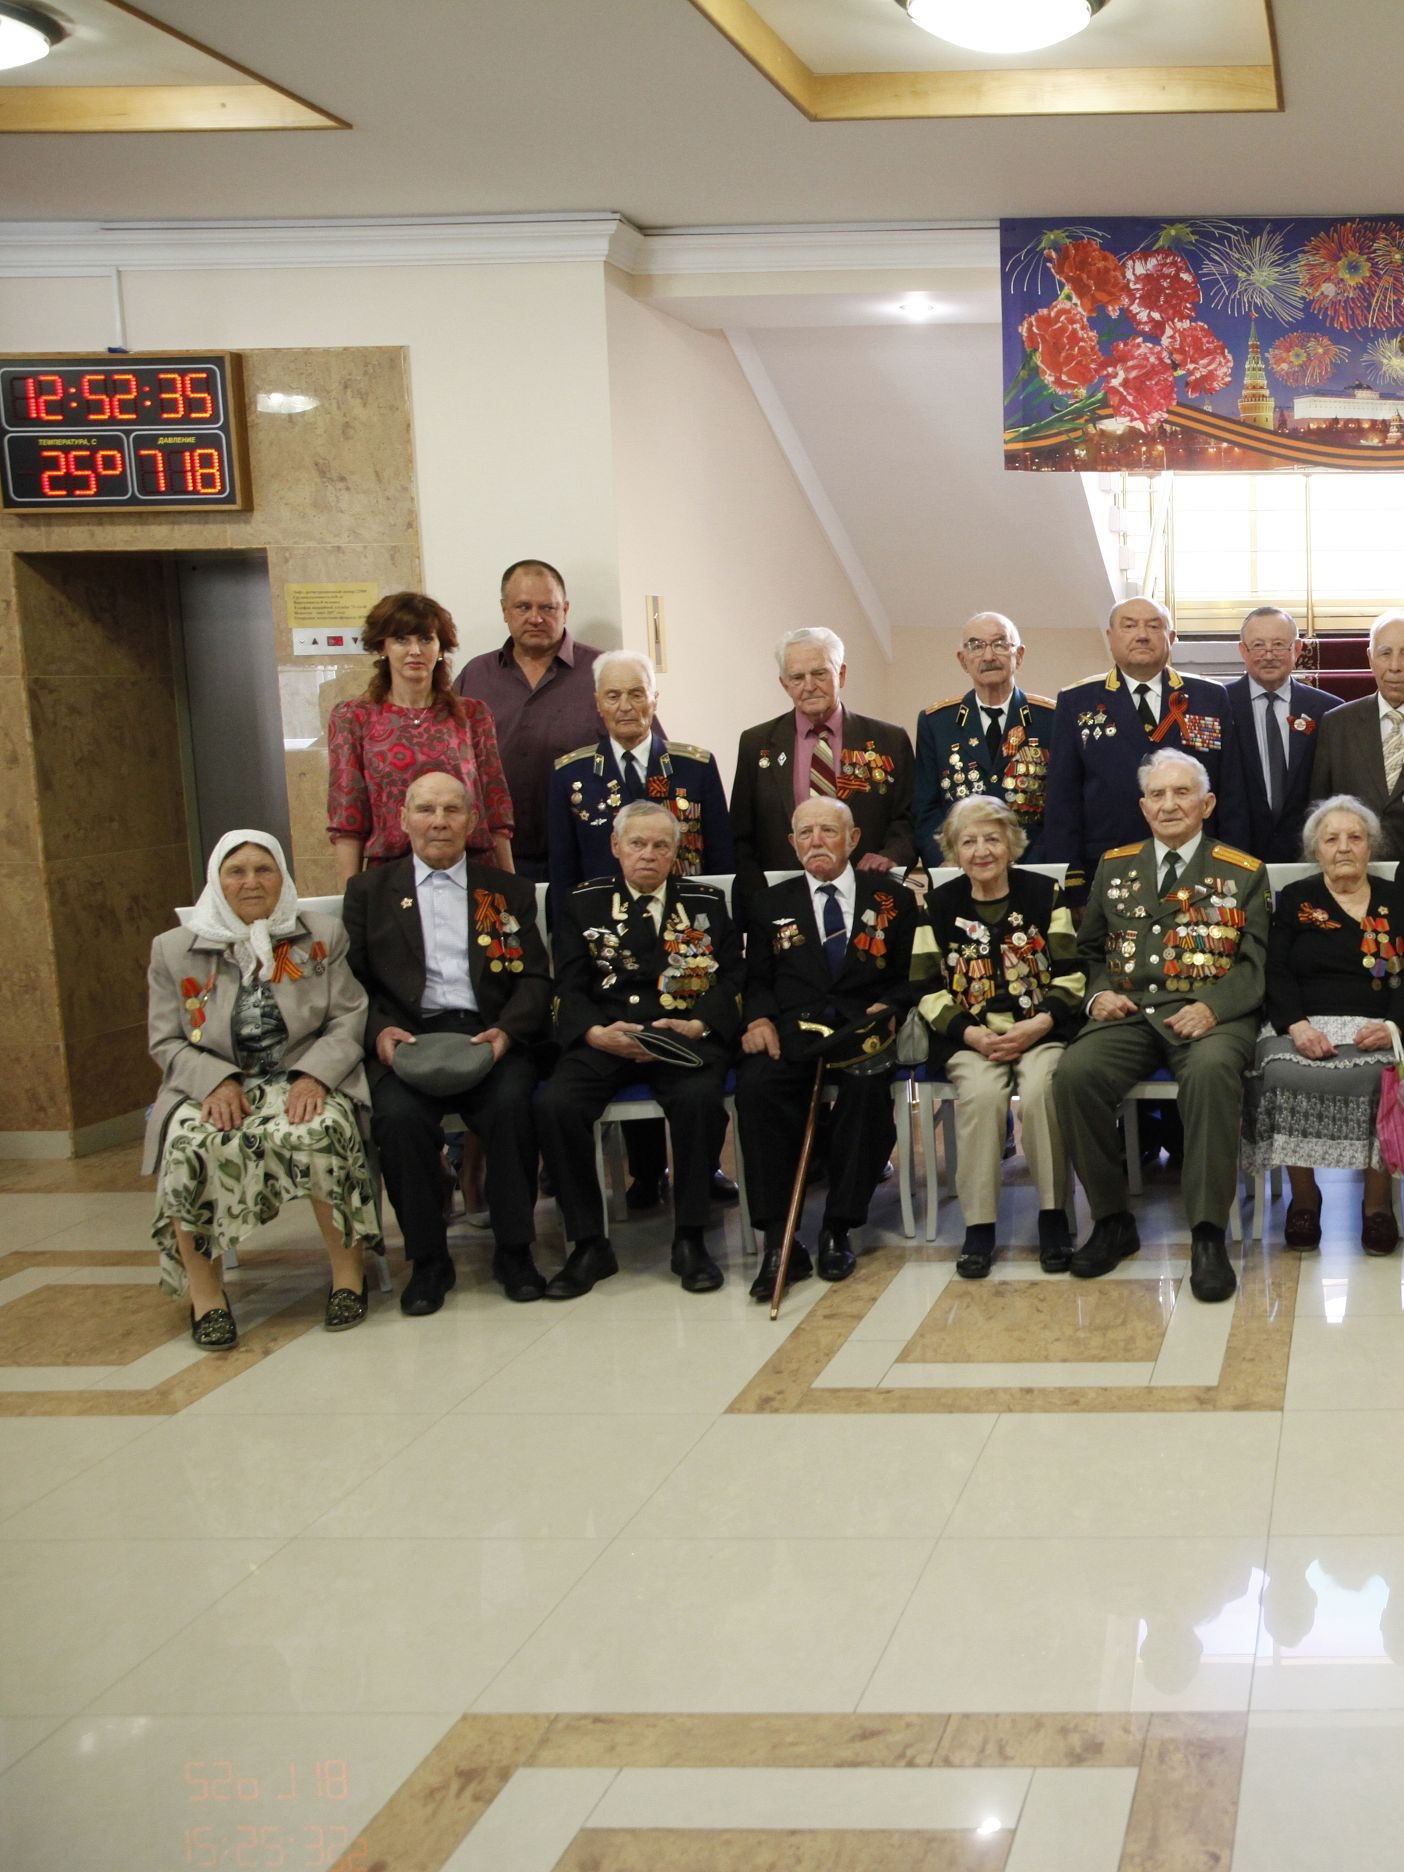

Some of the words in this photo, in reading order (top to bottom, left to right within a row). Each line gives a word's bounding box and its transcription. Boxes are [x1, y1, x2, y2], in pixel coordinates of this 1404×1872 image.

[26, 372, 213, 420] 12:52:35
[157, 436, 197, 446] ДАВЛЕНИЕ
[137, 448, 222, 494] 718
